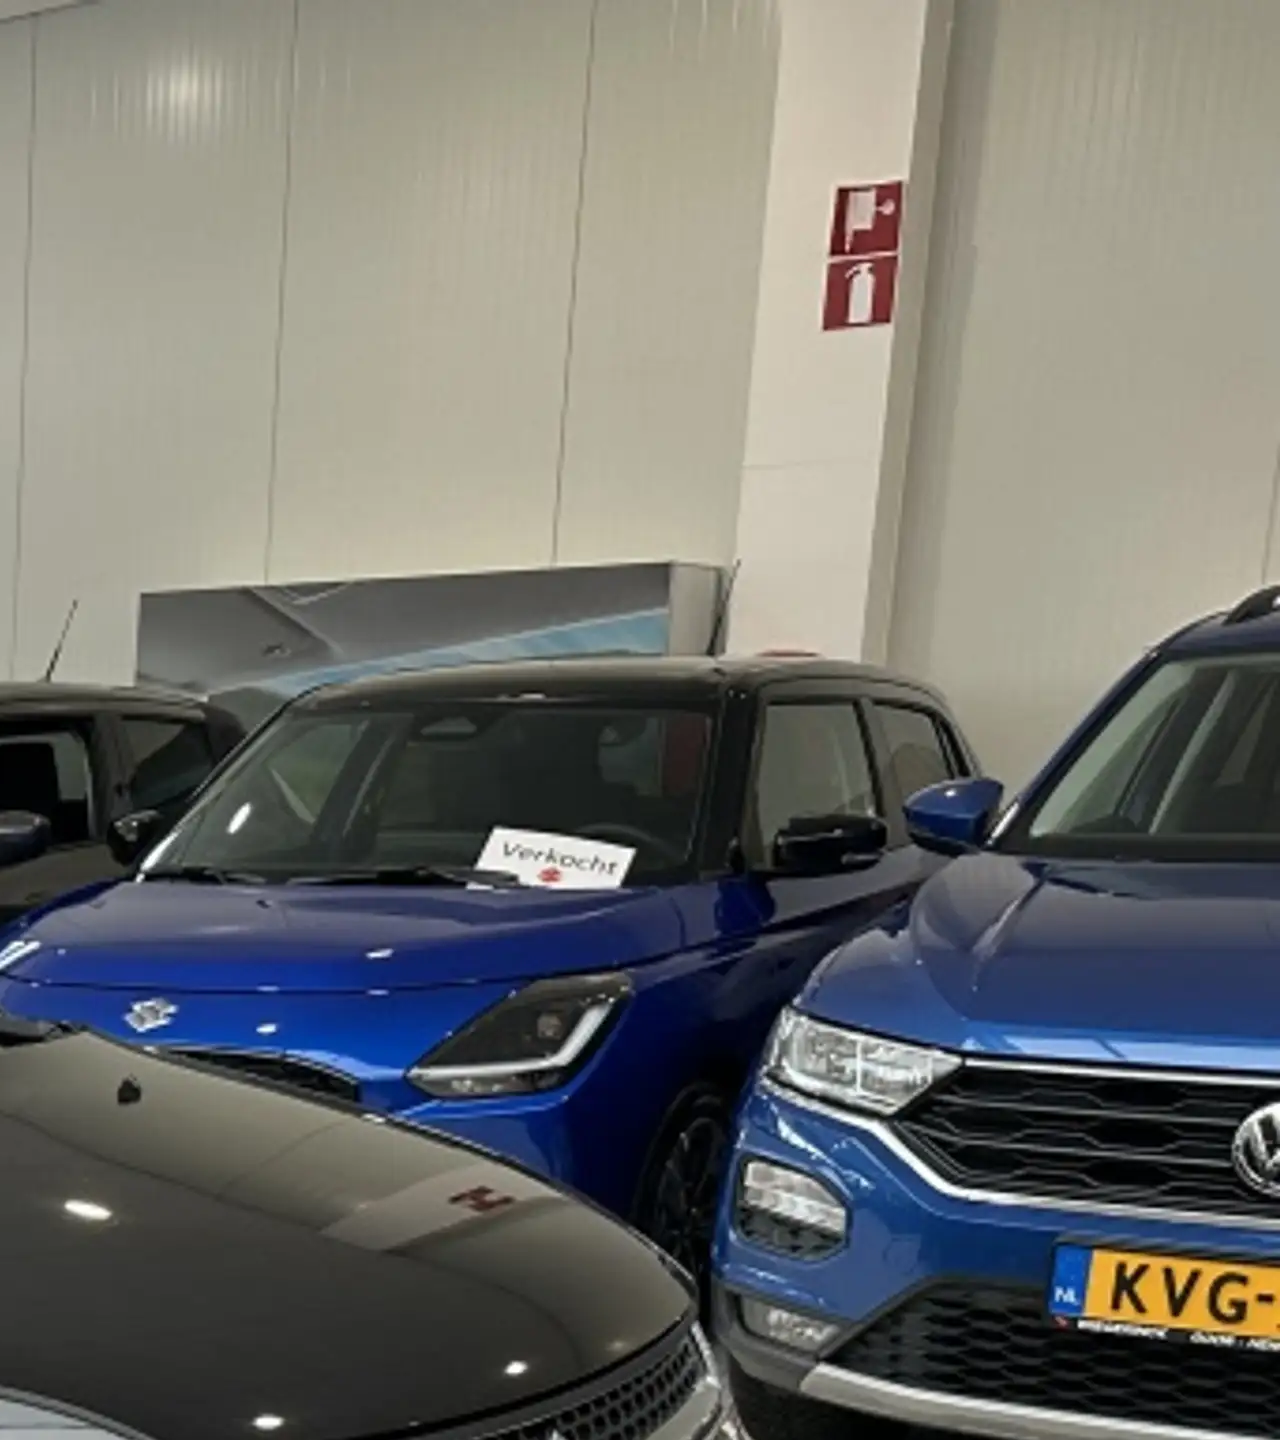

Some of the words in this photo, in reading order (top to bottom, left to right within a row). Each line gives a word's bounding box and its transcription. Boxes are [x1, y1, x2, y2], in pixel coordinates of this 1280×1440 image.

[502, 841, 618, 876] Verkocht
[1054, 1286, 1078, 1305] NL
[1111, 1261, 1280, 1329] KVG-
